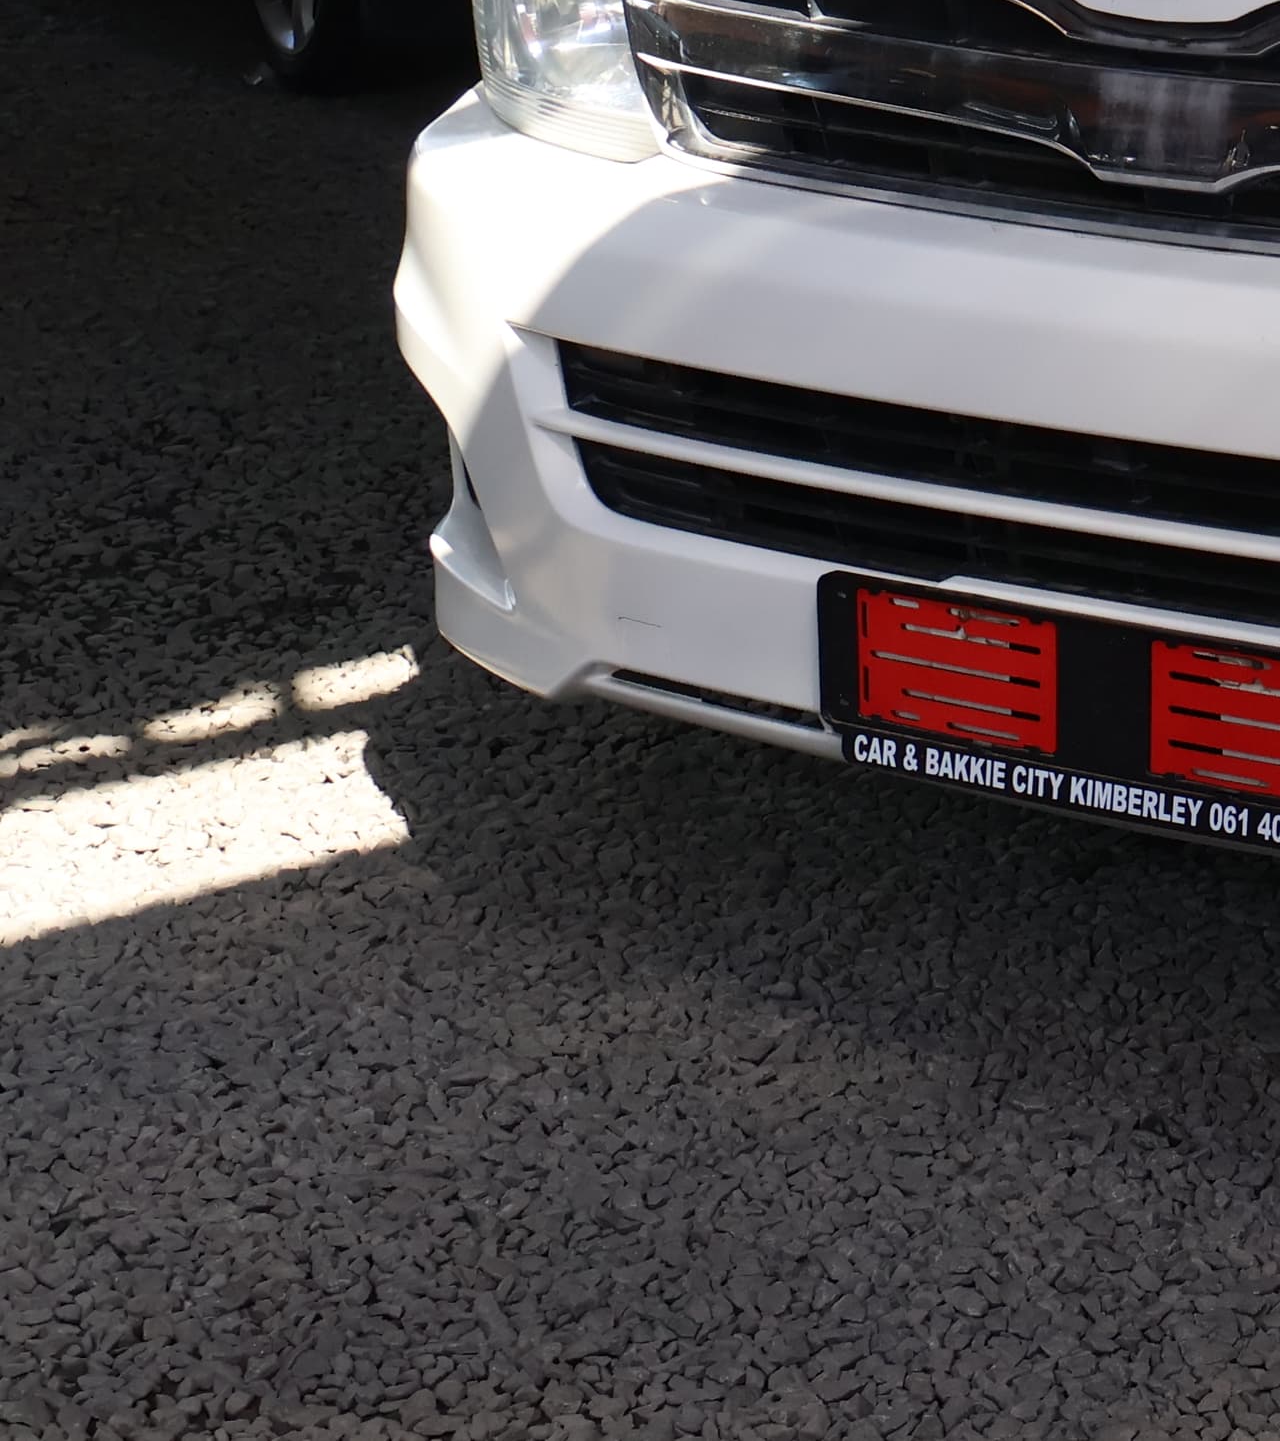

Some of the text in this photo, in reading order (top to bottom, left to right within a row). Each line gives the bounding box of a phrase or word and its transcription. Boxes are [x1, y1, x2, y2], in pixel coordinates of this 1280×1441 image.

[854, 735, 897, 768] CAR
[903, 749, 919, 772] &
[925, 747, 1006, 789] BAKKIE
[1012, 764, 1065, 801] CITY
[1069, 777, 1203, 828] KIMBERLEY
[1209, 801, 1249, 837] 061
